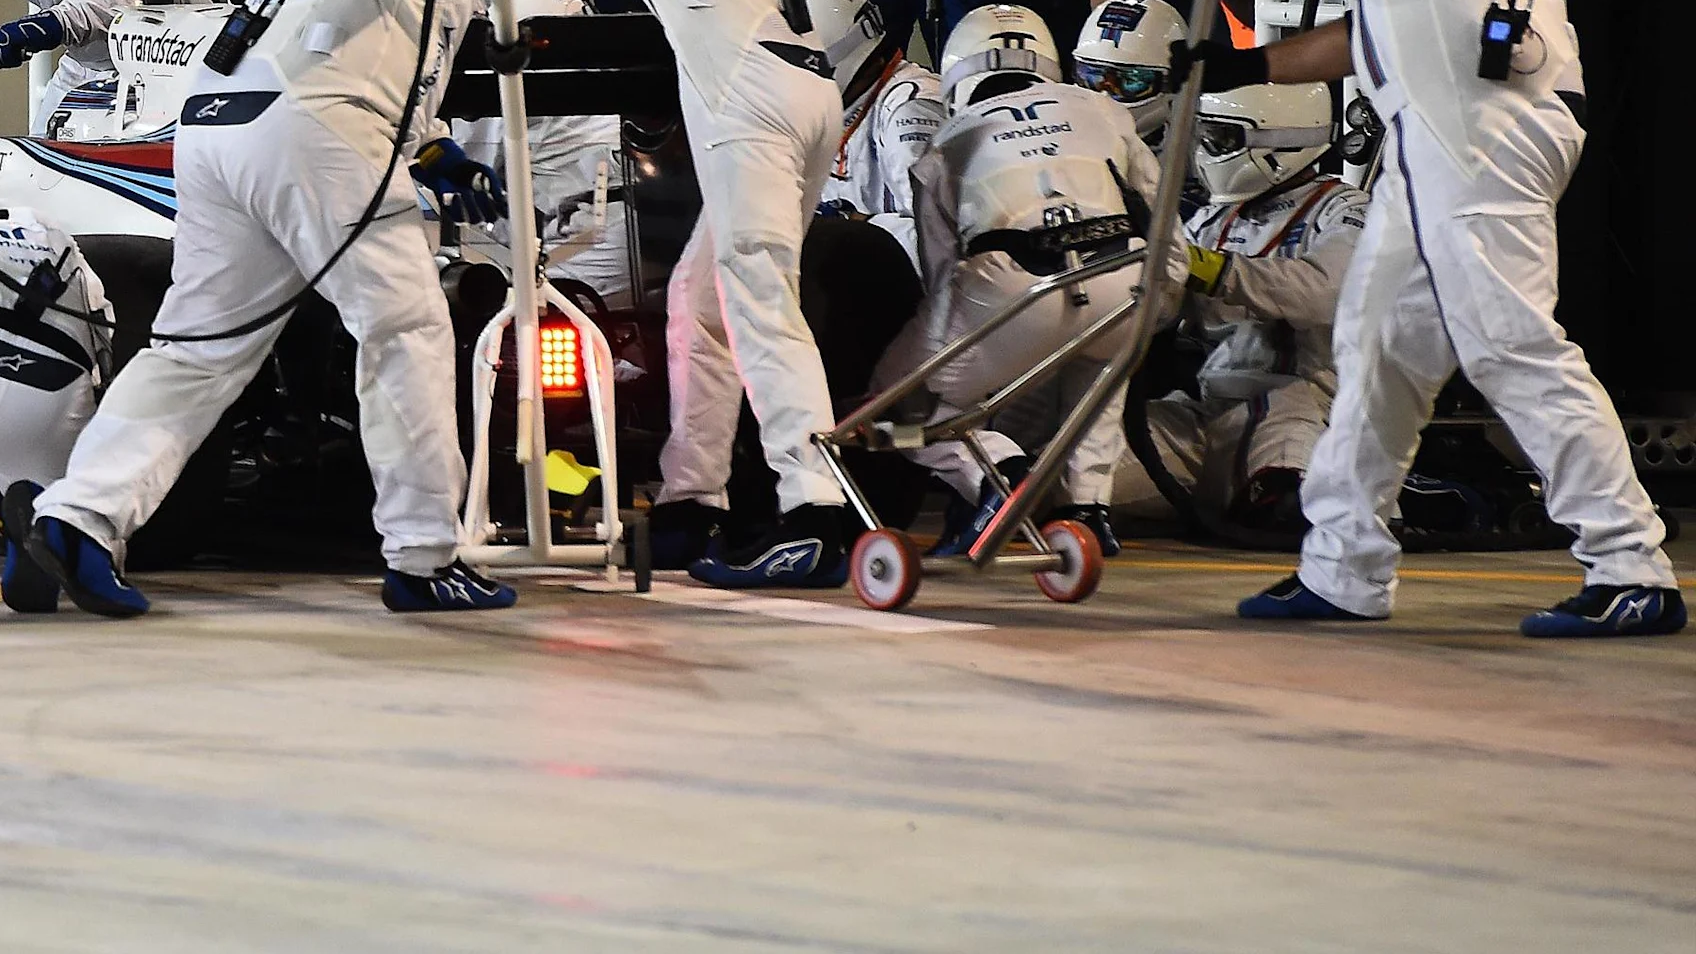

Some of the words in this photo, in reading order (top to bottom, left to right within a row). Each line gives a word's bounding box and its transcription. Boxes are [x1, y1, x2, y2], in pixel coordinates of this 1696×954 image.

[131, 29, 207, 67] randstad
[58, 128, 76, 139] ORIS
[993, 122, 1073, 143] randstad
